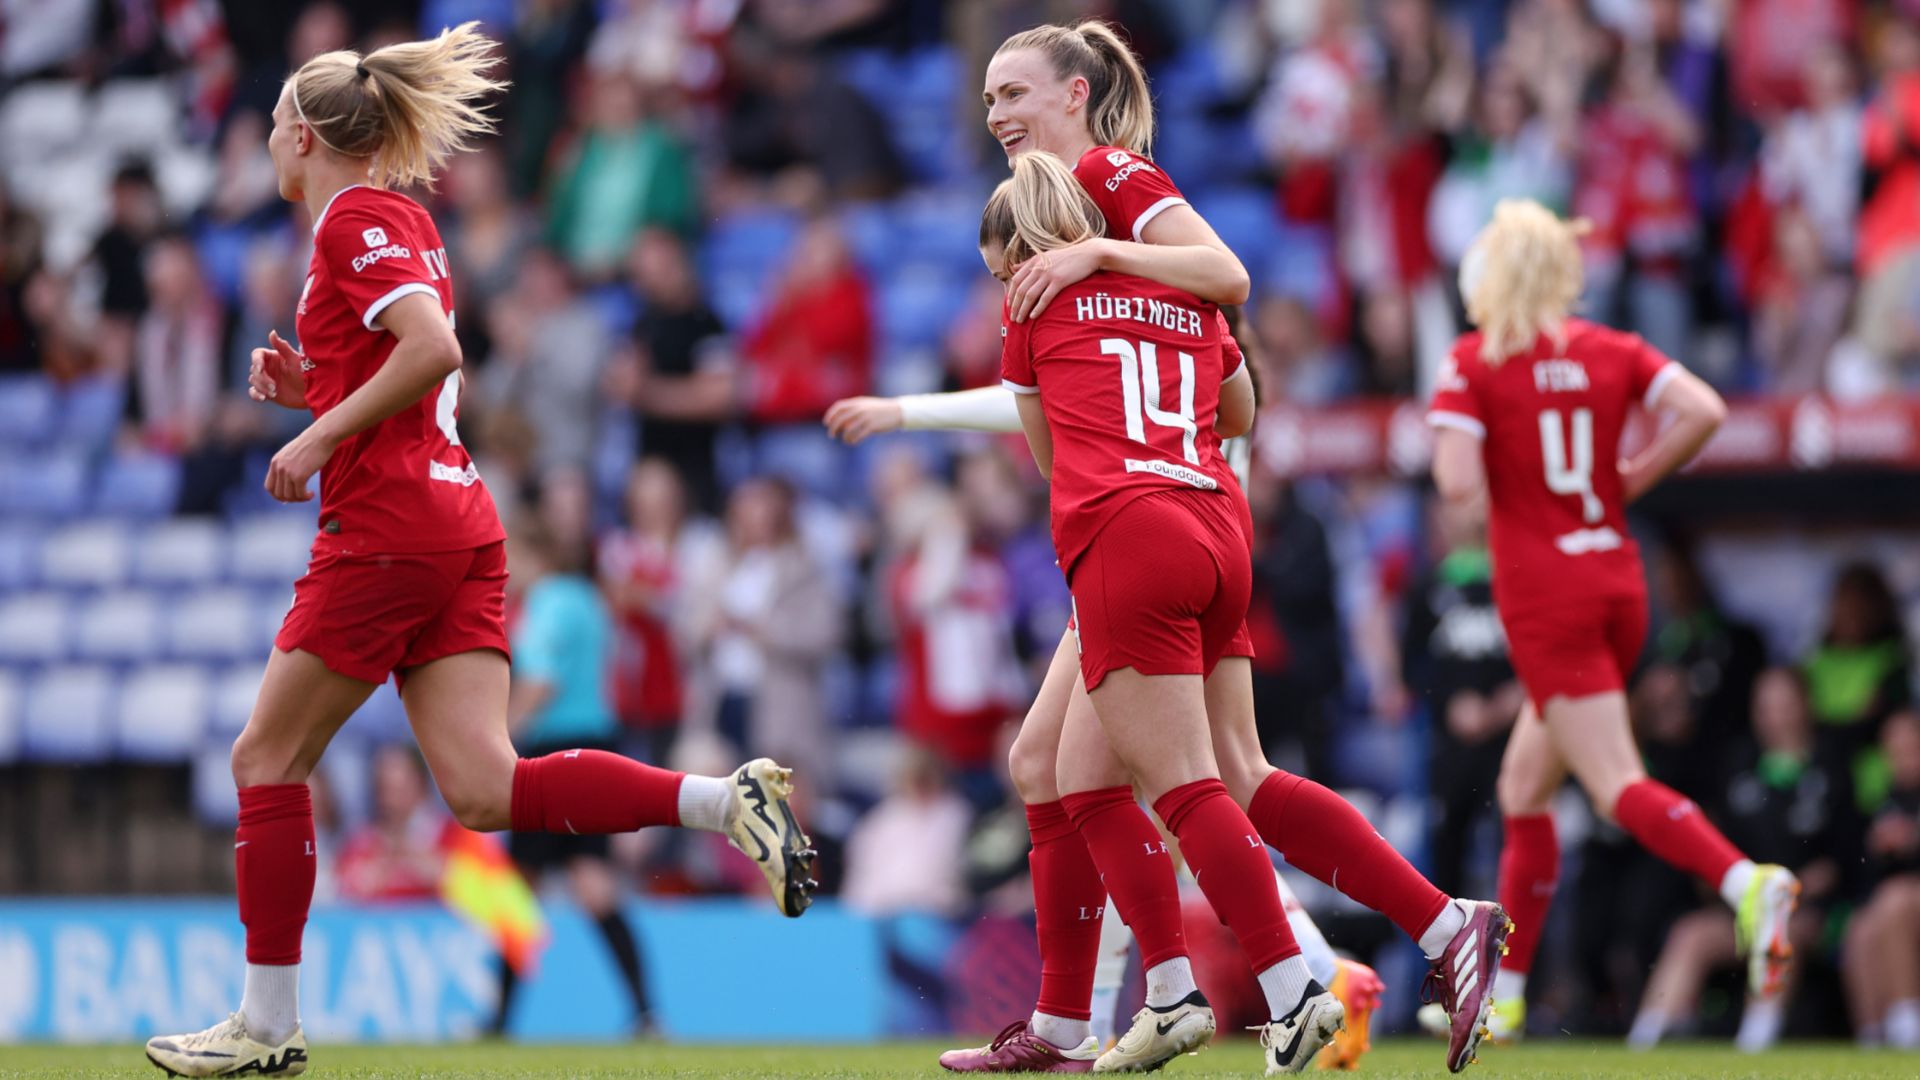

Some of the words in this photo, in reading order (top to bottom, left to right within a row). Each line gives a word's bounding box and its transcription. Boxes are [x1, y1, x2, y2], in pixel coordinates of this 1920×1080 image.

[352, 244, 411, 273] Expedia
[1075, 292, 1203, 337] HÖBINGER
[1100, 337, 1200, 466] 14
[1145, 462, 1214, 490] Foundation
[1538, 407, 1605, 523] 4
[52, 924, 500, 1042] BARLAYS
